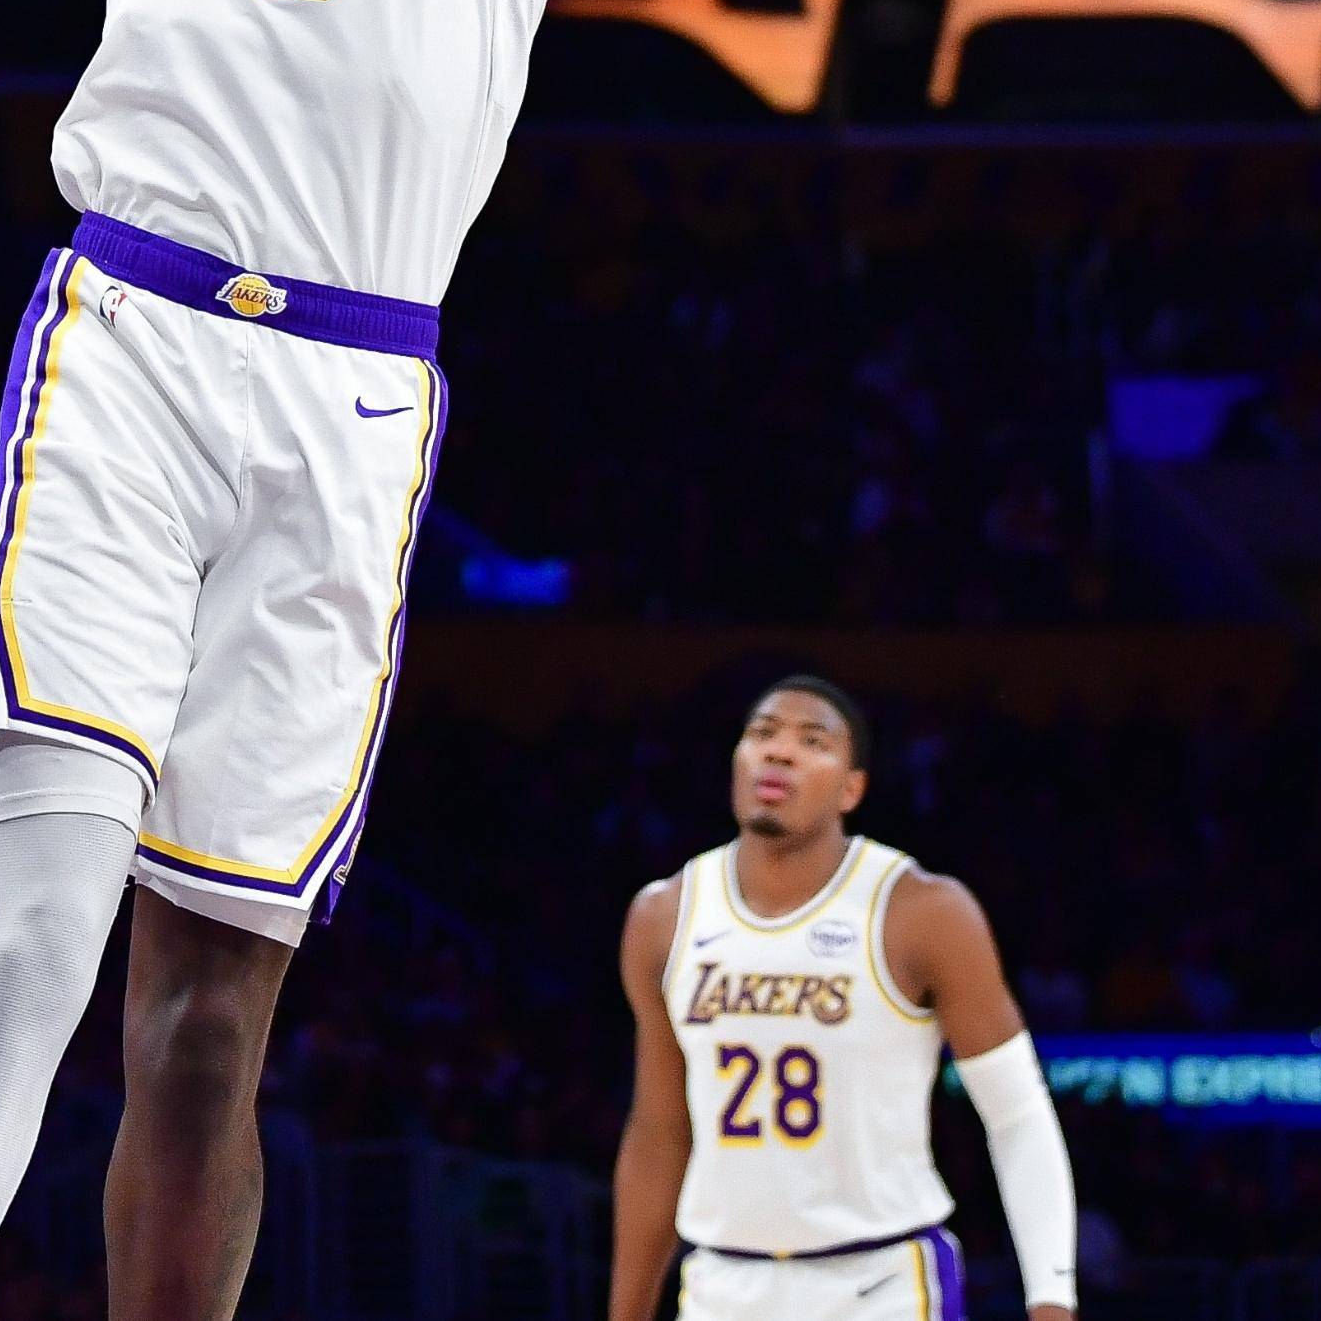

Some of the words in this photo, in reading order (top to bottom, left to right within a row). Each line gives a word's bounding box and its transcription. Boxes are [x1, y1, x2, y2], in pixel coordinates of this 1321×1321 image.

[218, 280, 286, 312] LAKERS
[684, 961, 854, 1026] LAKERS
[716, 1041, 825, 1151] 28
